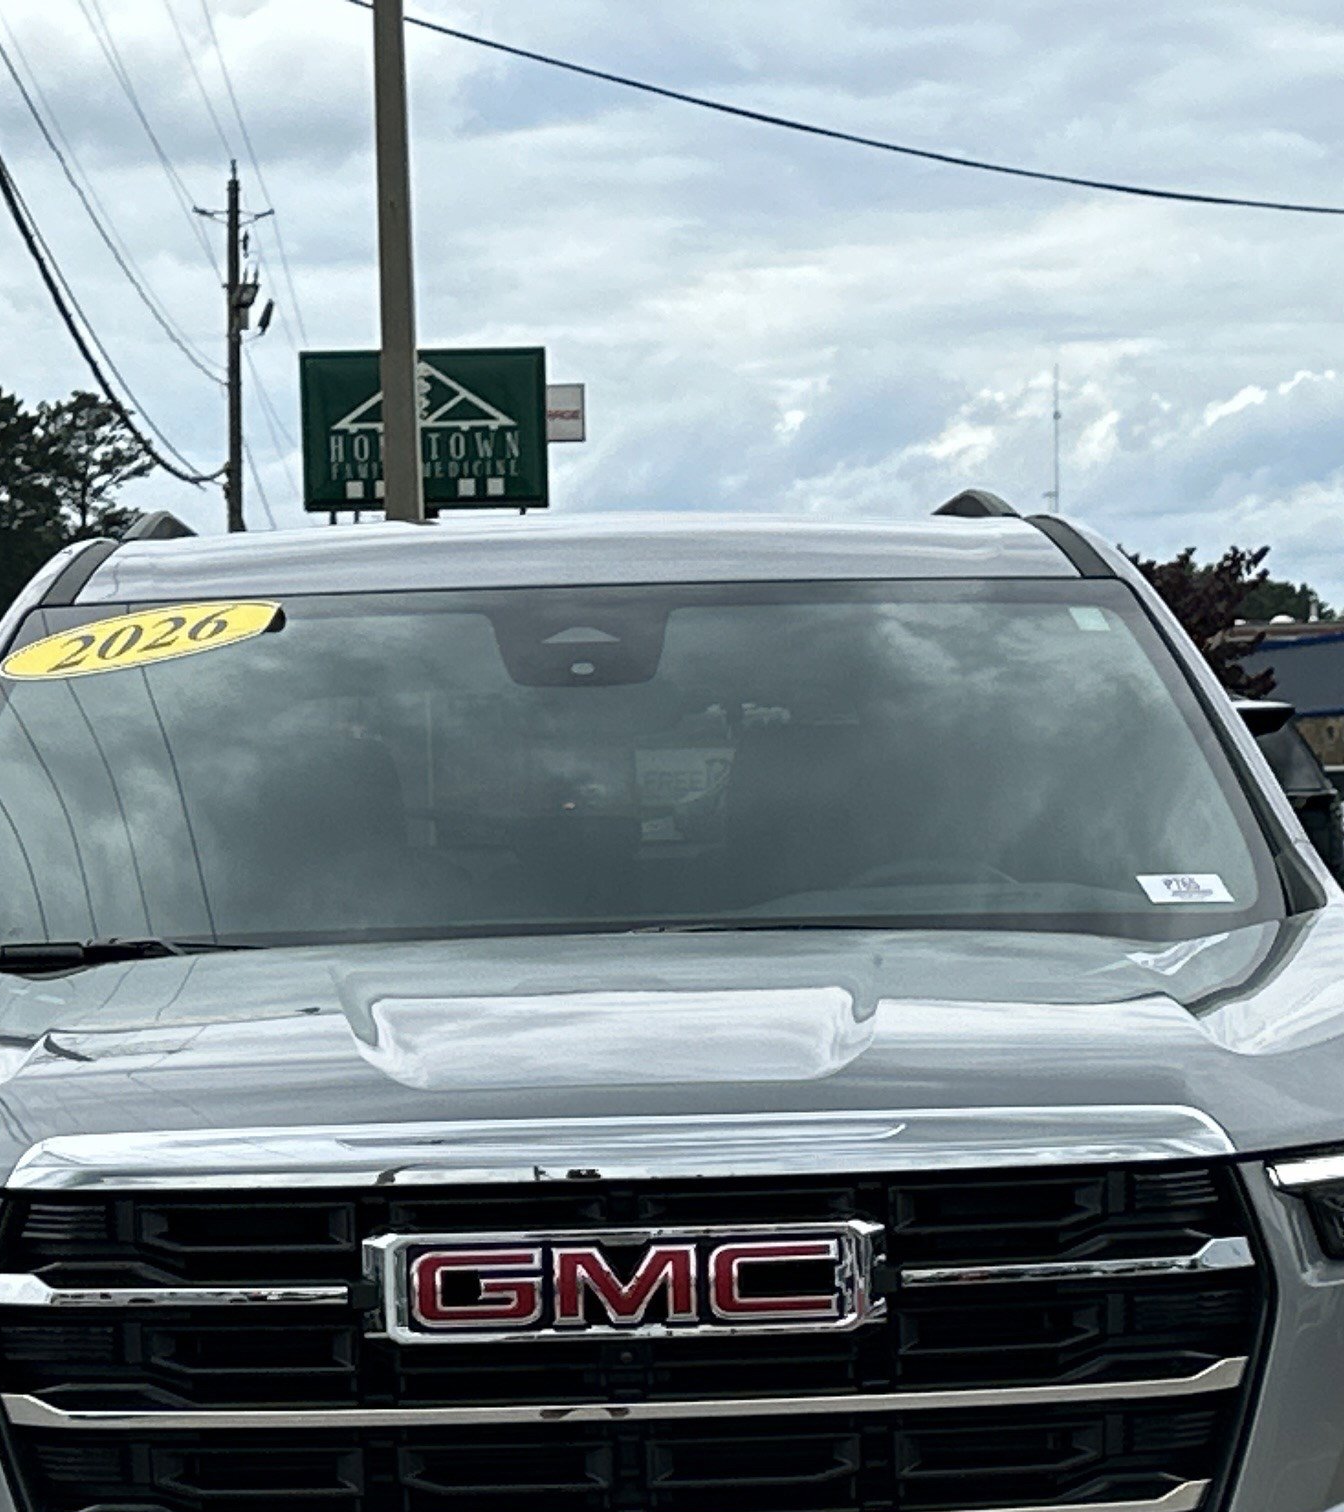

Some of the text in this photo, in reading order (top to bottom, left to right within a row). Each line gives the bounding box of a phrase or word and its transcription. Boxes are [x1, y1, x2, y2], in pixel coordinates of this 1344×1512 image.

[330, 432, 520, 463] HOTOWN
[47, 604, 238, 673] 2026
[410, 1239, 840, 1327] GMC
